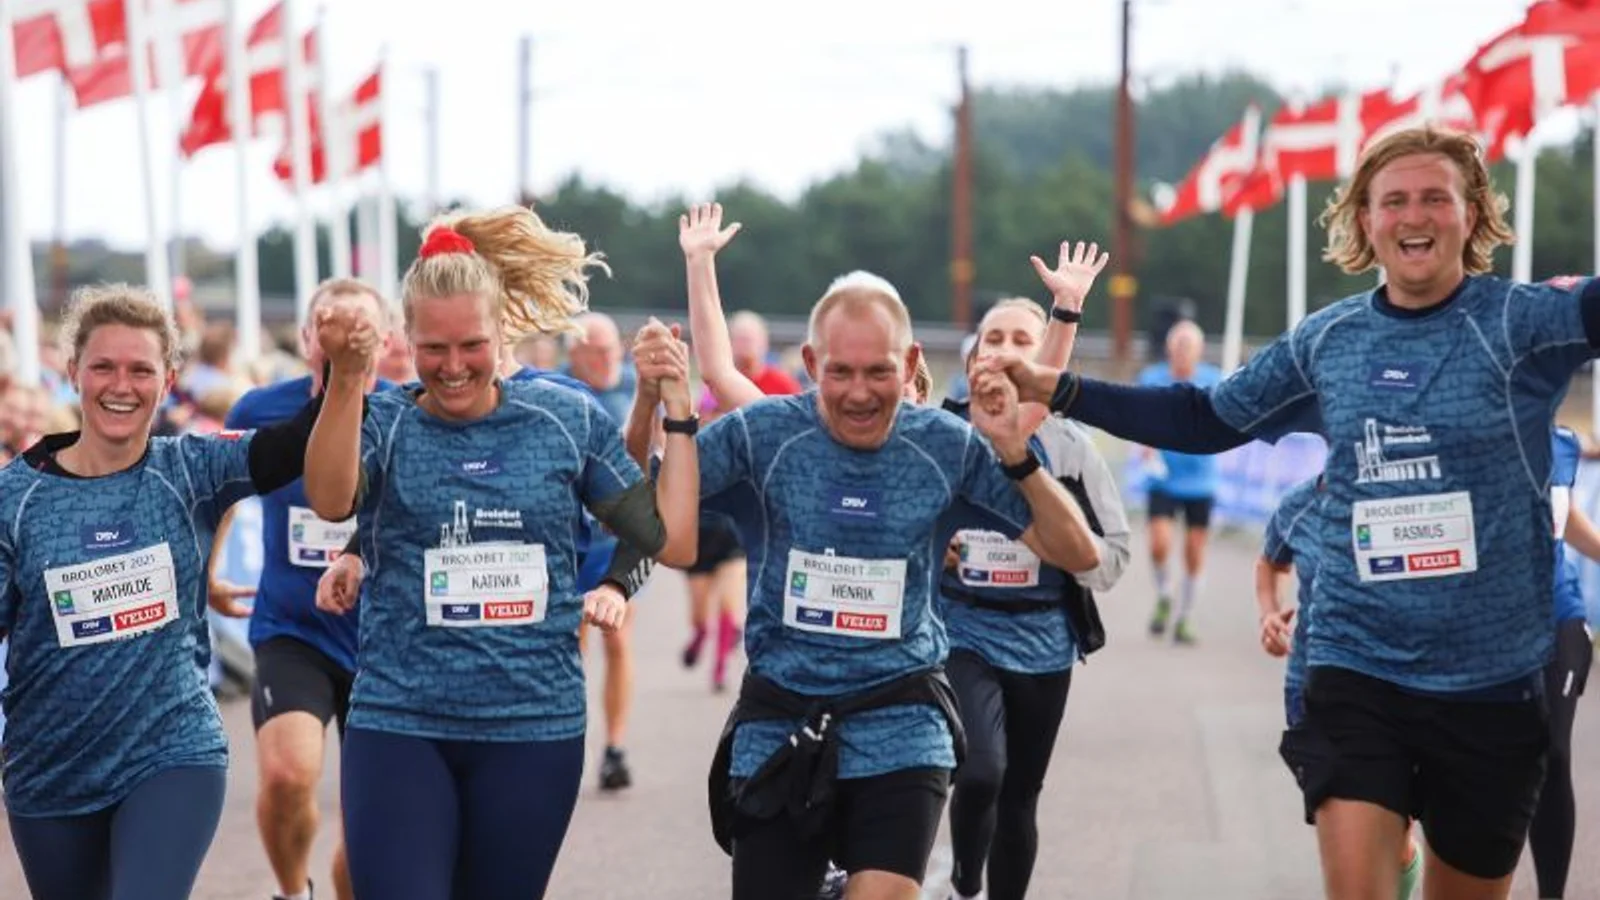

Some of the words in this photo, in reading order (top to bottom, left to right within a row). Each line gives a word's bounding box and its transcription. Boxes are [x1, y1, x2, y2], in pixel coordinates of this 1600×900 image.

[95, 530, 120, 542] DSV
[1393, 523, 1444, 541] RASMUS
[62, 560, 126, 584] BROLØBET
[130, 554, 156, 569] 2021
[804, 558, 865, 577] BROLØBET
[1411, 554, 1456, 569] VELUX
[472, 573, 522, 589] KATINKA
[92, 577, 153, 604] MATHILDE
[832, 583, 876, 601] HENRIK
[118, 605, 164, 626] VELUX
[487, 604, 530, 618] VELUX
[840, 614, 885, 629] VELUX
